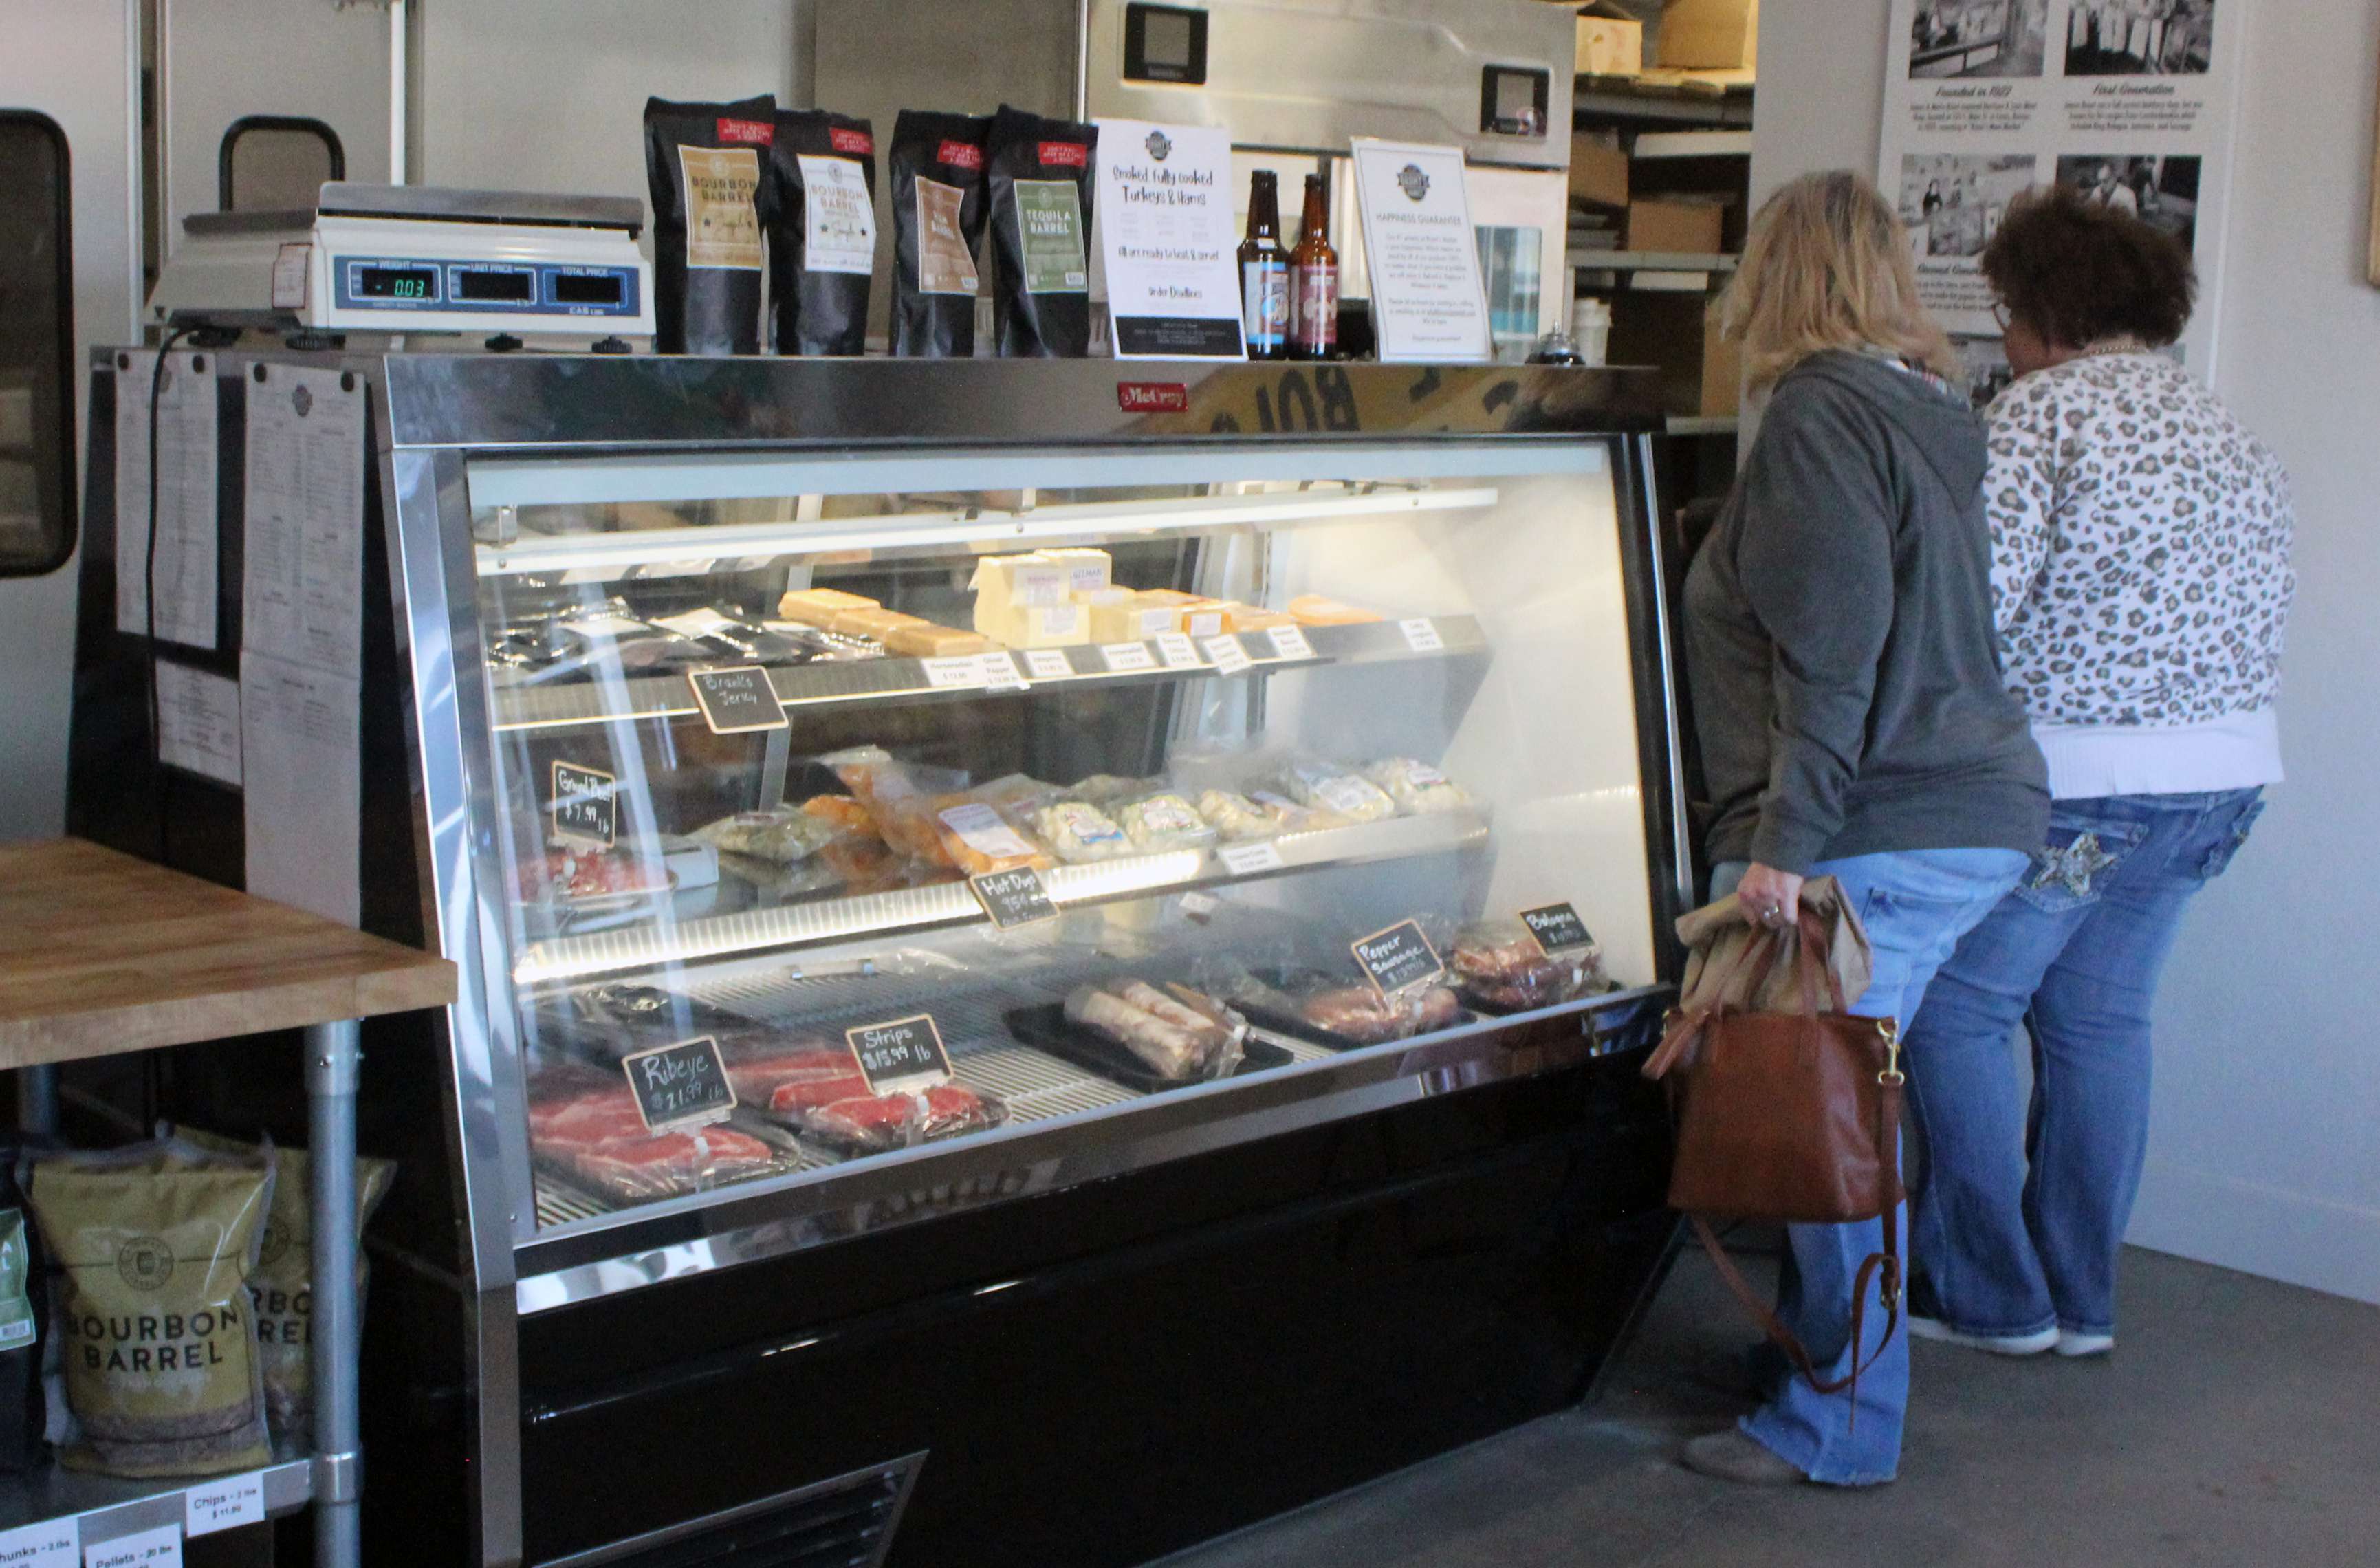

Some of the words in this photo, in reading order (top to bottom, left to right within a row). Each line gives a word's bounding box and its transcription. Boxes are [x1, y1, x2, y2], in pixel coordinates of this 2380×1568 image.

[1122, 185, 1166, 205] Turkeys
[1026, 209, 1071, 221] TEQUILA
[1030, 222, 1069, 235] BARREL
[378, 260, 411, 269] WEIGHT
[562, 265, 583, 276] TOTAL
[981, 877, 1010, 896] Hot
[1359, 935, 1400, 961] Pepper
[864, 1027, 913, 1048] Strips
[914, 1045, 931, 1063] lb
[642, 1053, 708, 1091] Ribeye
[85, 1341, 223, 1371] BARREL
[195, 1495, 226, 1509] Chips
[0, 1547, 36, 1562] hunks
[96, 1553, 135, 1568] Pellets
